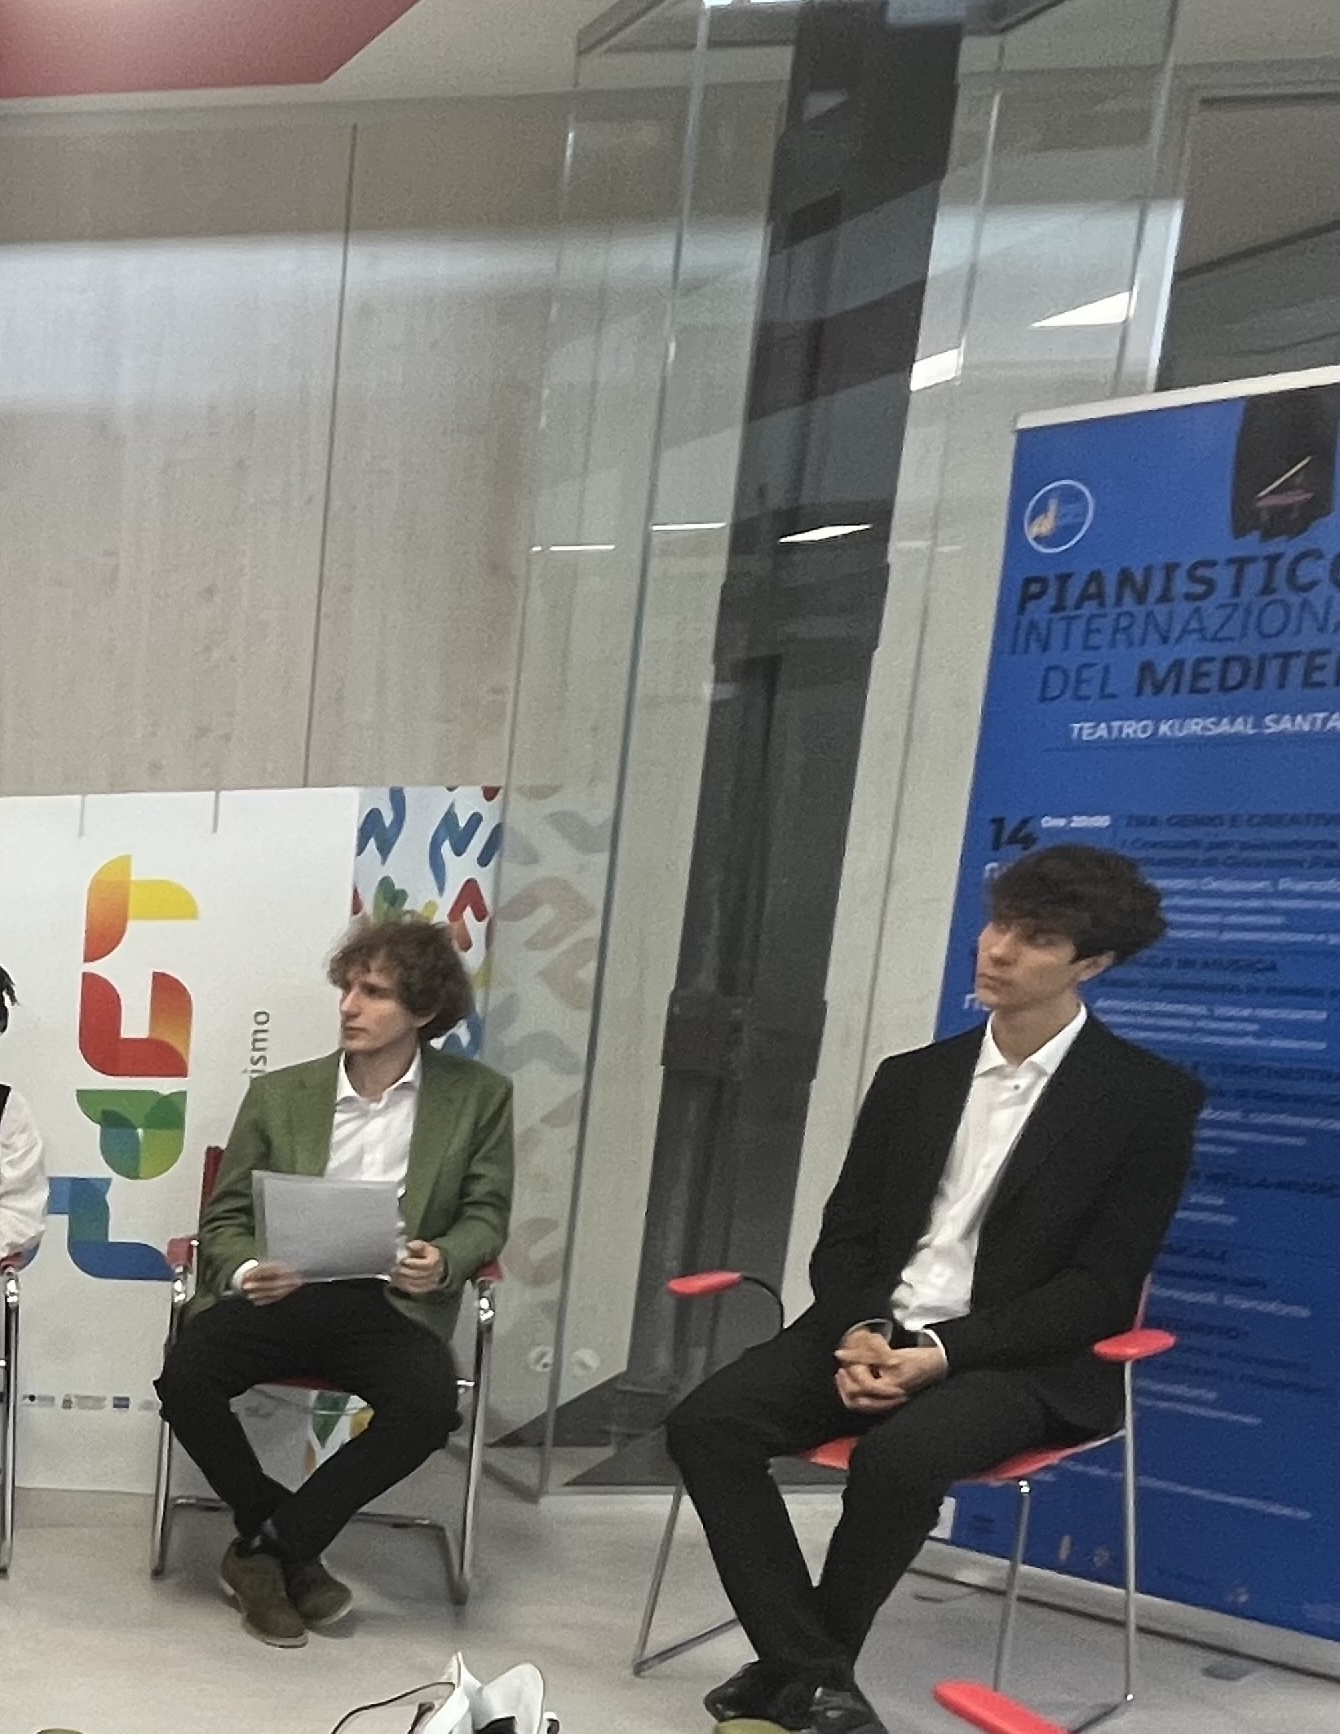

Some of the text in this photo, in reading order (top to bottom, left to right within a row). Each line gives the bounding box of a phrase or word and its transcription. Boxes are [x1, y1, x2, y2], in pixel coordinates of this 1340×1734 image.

[1017, 546, 1340, 617] PIANISTIC
[1039, 649, 1340, 703] DEL MEDITE
[1069, 719, 1153, 741] TEATRO
[1157, 714, 1259, 739] KURSAAL
[990, 815, 1039, 852] 14
[241, 1010, 270, 1075] ismo
